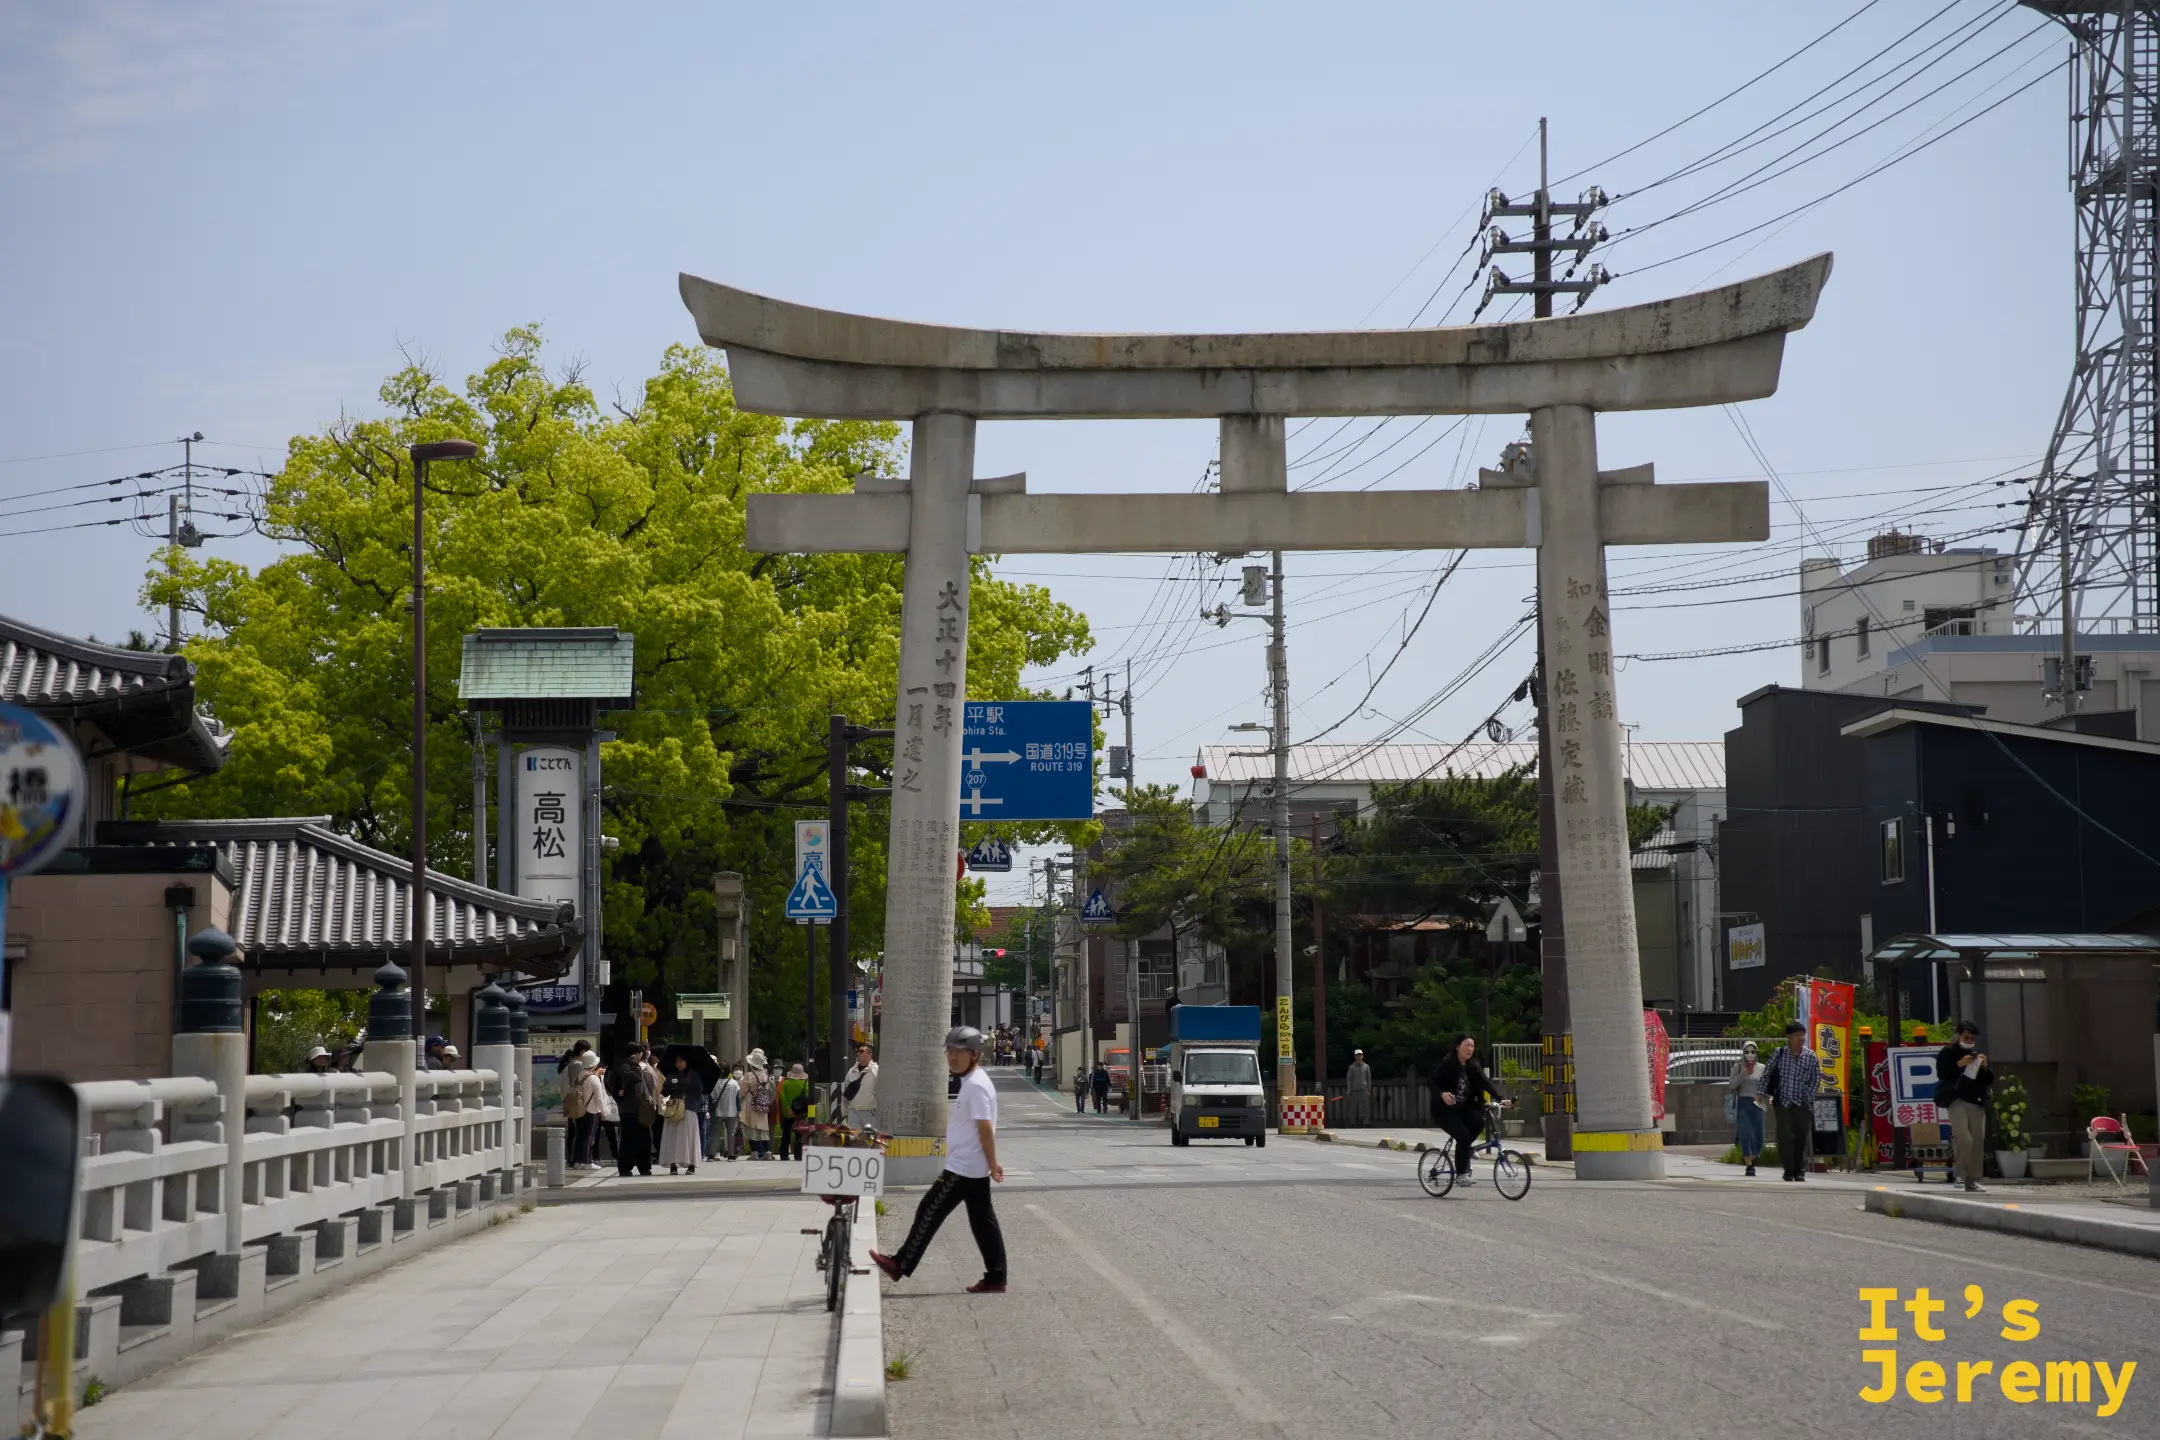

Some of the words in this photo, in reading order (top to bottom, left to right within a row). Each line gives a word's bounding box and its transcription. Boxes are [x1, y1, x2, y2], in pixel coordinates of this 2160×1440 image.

[933, 581, 963, 738] 大正十四年
[967, 706, 1004, 723] 平駅
[963, 726, 985, 735] ohira
[988, 726, 1006, 735] Sta.
[1025, 743, 1087, 760] 国道319号
[540, 758, 572, 770] ことでん
[1031, 762, 1063, 771] ROUTE
[1067, 762, 1083, 771] 319
[968, 775, 984, 785] 207
[533, 791, 566, 859] 高松
[1900, 1057, 1939, 1098] P
[805, 1155, 880, 1189] P500
[864, 1181, 877, 1193] 円
